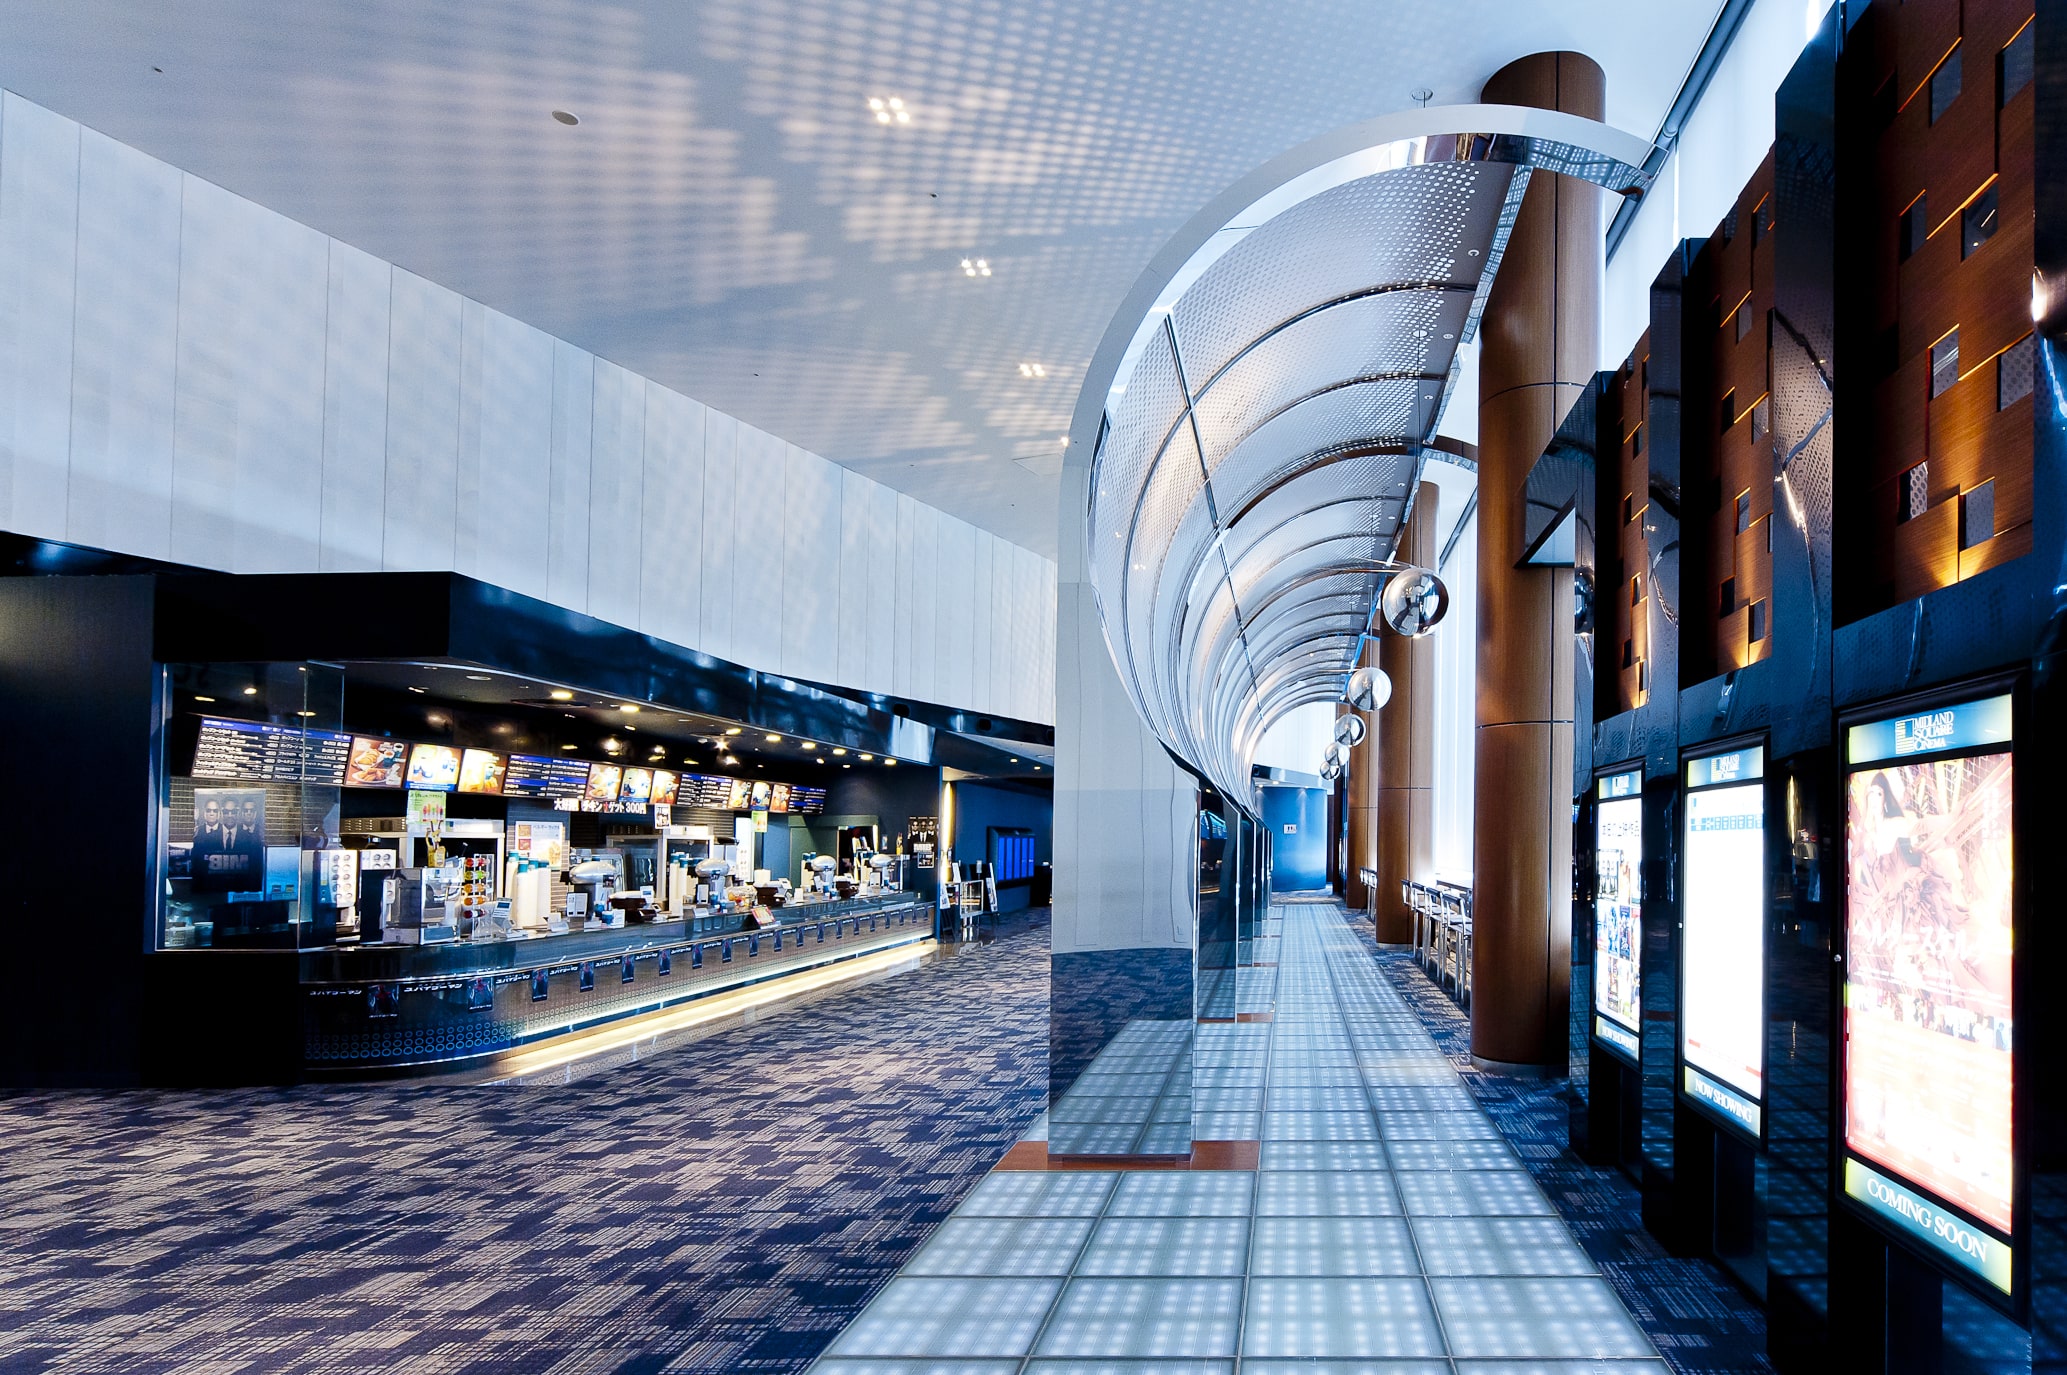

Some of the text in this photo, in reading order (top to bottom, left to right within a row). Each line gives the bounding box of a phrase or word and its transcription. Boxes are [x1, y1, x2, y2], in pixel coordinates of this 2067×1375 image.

[1914, 710, 1954, 729] MIDLAND
[1914, 722, 1954, 739] SQUARE
[1914, 737, 1947, 751] CINEMA
[625, 802, 646, 814] 300円
[1695, 1077, 1753, 1123] NOW SHOWING
[1867, 1178, 1988, 1262] COMING SOON
